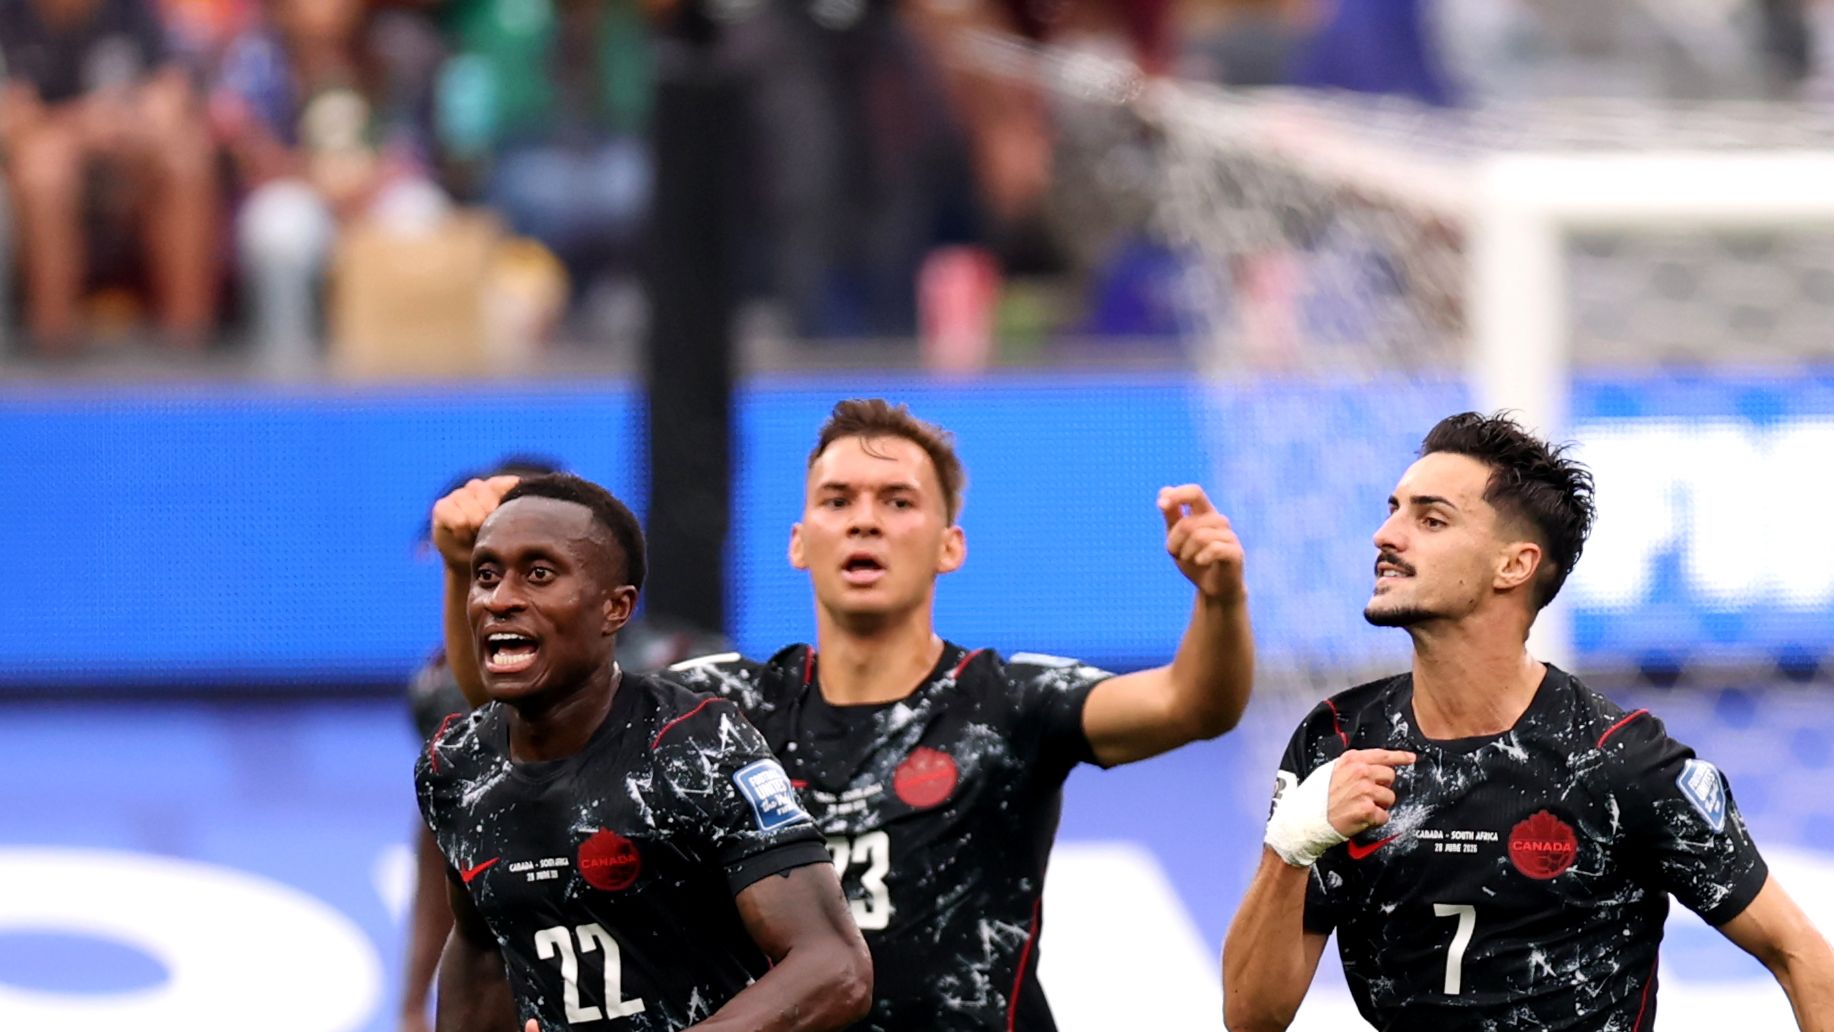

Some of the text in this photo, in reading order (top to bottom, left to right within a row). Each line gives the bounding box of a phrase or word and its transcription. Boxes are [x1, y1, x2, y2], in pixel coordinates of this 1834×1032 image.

[1450, 831, 1474, 840] SOUTH
[1475, 831, 1499, 841] AFRICA
[1512, 840, 1572, 851] CANADA
[581, 855, 637, 869] CANADA
[1433, 903, 1476, 996] 7
[534, 922, 646, 1025] 22
